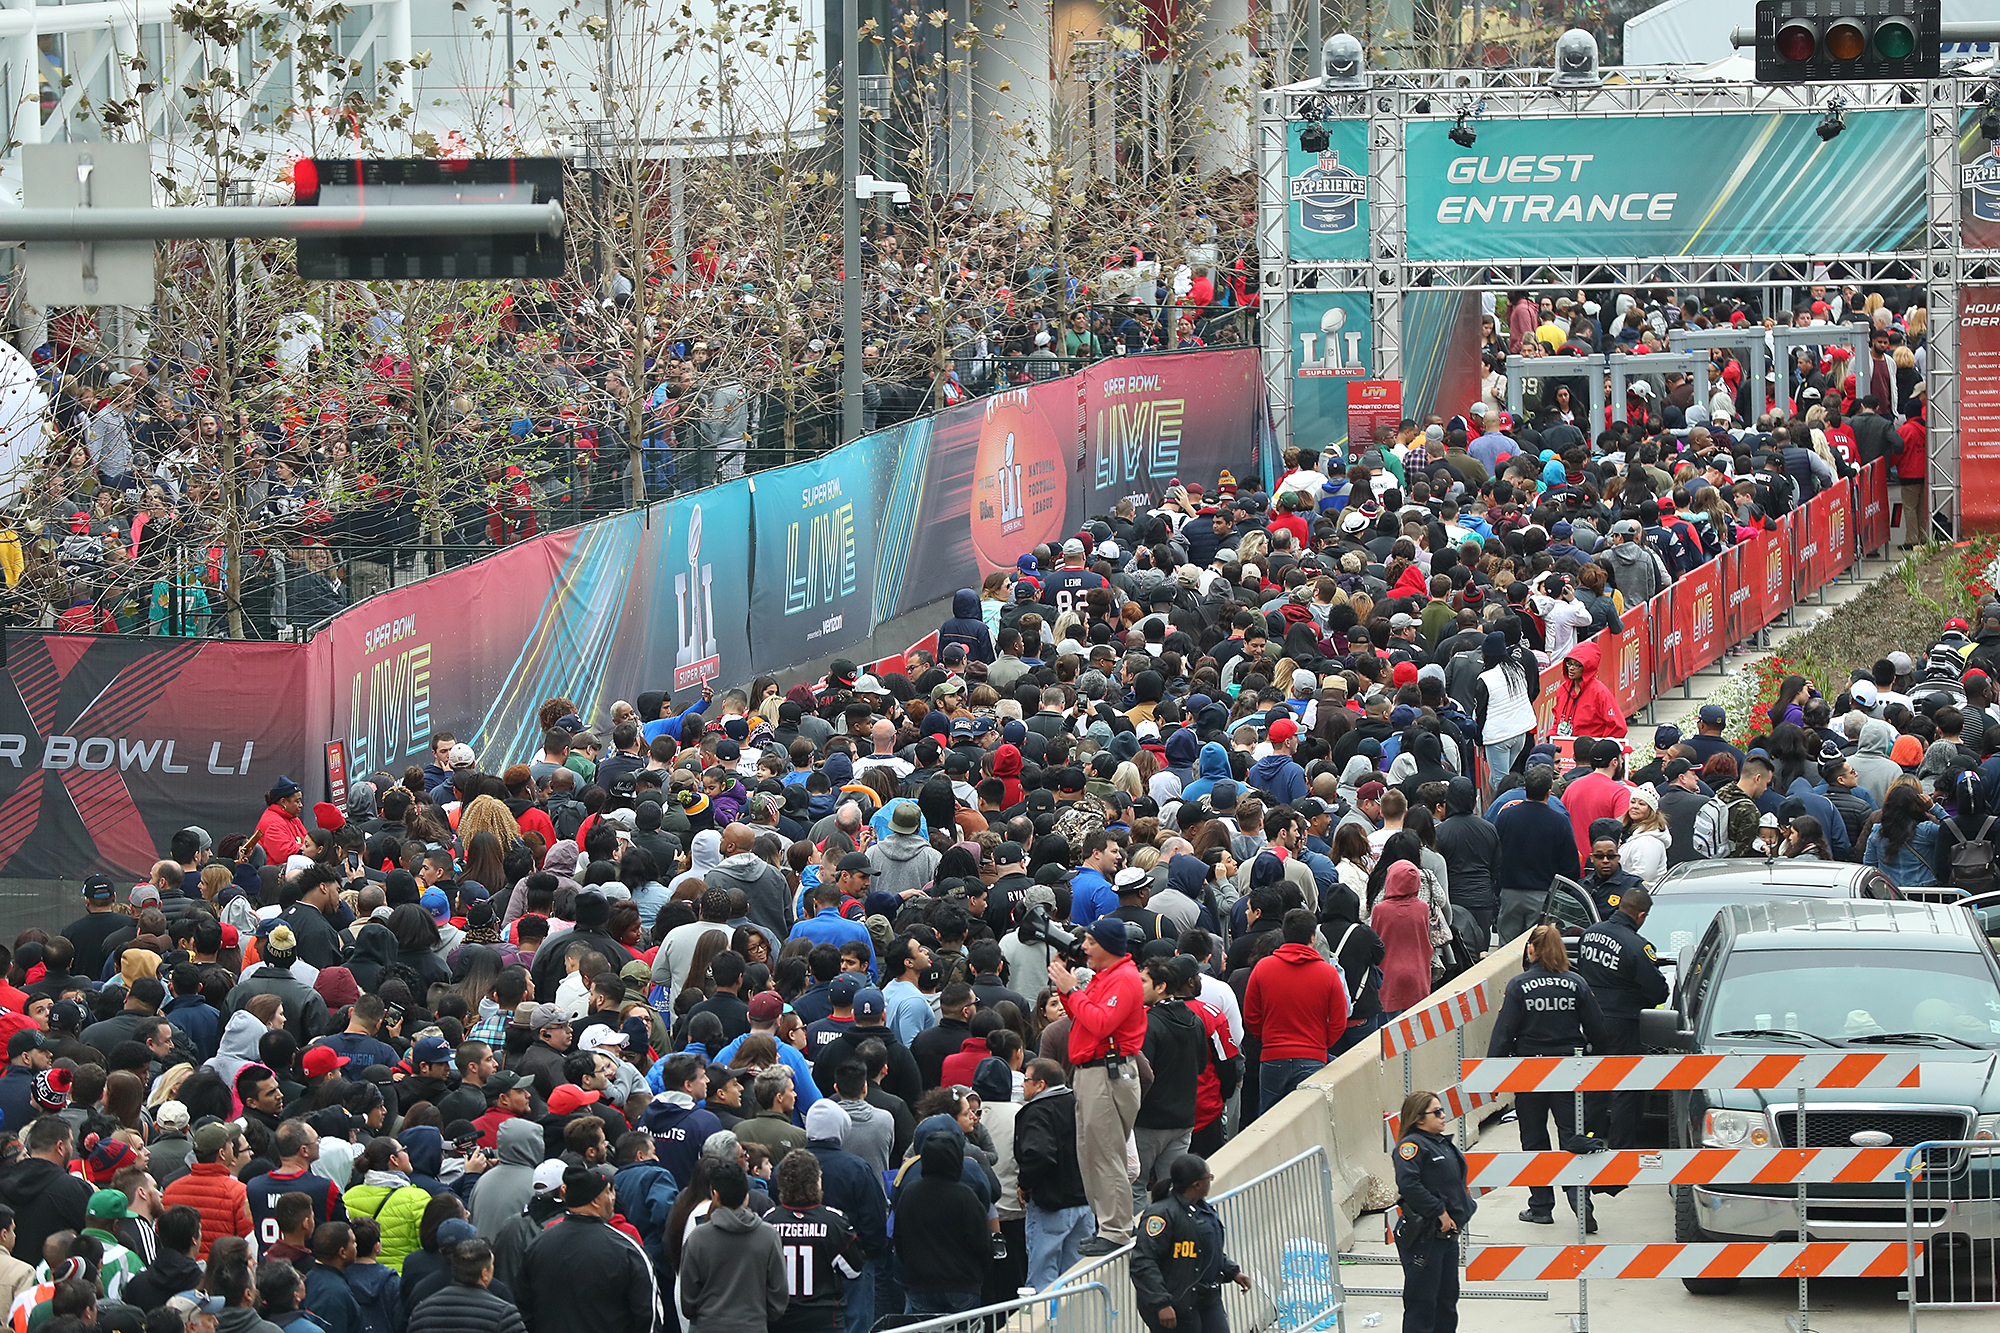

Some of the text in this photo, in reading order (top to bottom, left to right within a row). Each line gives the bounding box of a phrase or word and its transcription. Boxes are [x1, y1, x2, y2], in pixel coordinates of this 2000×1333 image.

[1320, 159, 1337, 171] NFL
[1446, 154, 1595, 184] GUEST
[1292, 178, 1365, 195] EXPERIENCE
[1436, 192, 1678, 224] ENTRANCE
[1961, 317, 2000, 327] OPER
[1103, 374, 1162, 398] SUPER BOWL
[1095, 398, 1185, 491] LIVE
[802, 477, 843, 509] SUPER BOWL
[784, 502, 856, 616] LIVE
[1064, 578, 1082, 588] LEHR
[1056, 589, 1090, 619] 82
[364, 613, 417, 656] SUPER BOWL
[822, 613, 843, 636] verizon
[679, 661, 715, 685] SUPER BOWL
[351, 642, 432, 785] LIVE
[42, 735, 189, 774] BOWL
[207, 740, 254, 775] LI
[267, 943, 293, 958] SAINTS
[1583, 931, 1623, 955] HOUSTON
[1580, 944, 1620, 971] POLICE
[1521, 977, 1578, 994] HOUSTON
[1525, 997, 1577, 1011] POLICE
[816, 1031, 843, 1045] HOP
[1173, 1241, 1198, 1258] POL
[783, 1245, 813, 1296] 11
